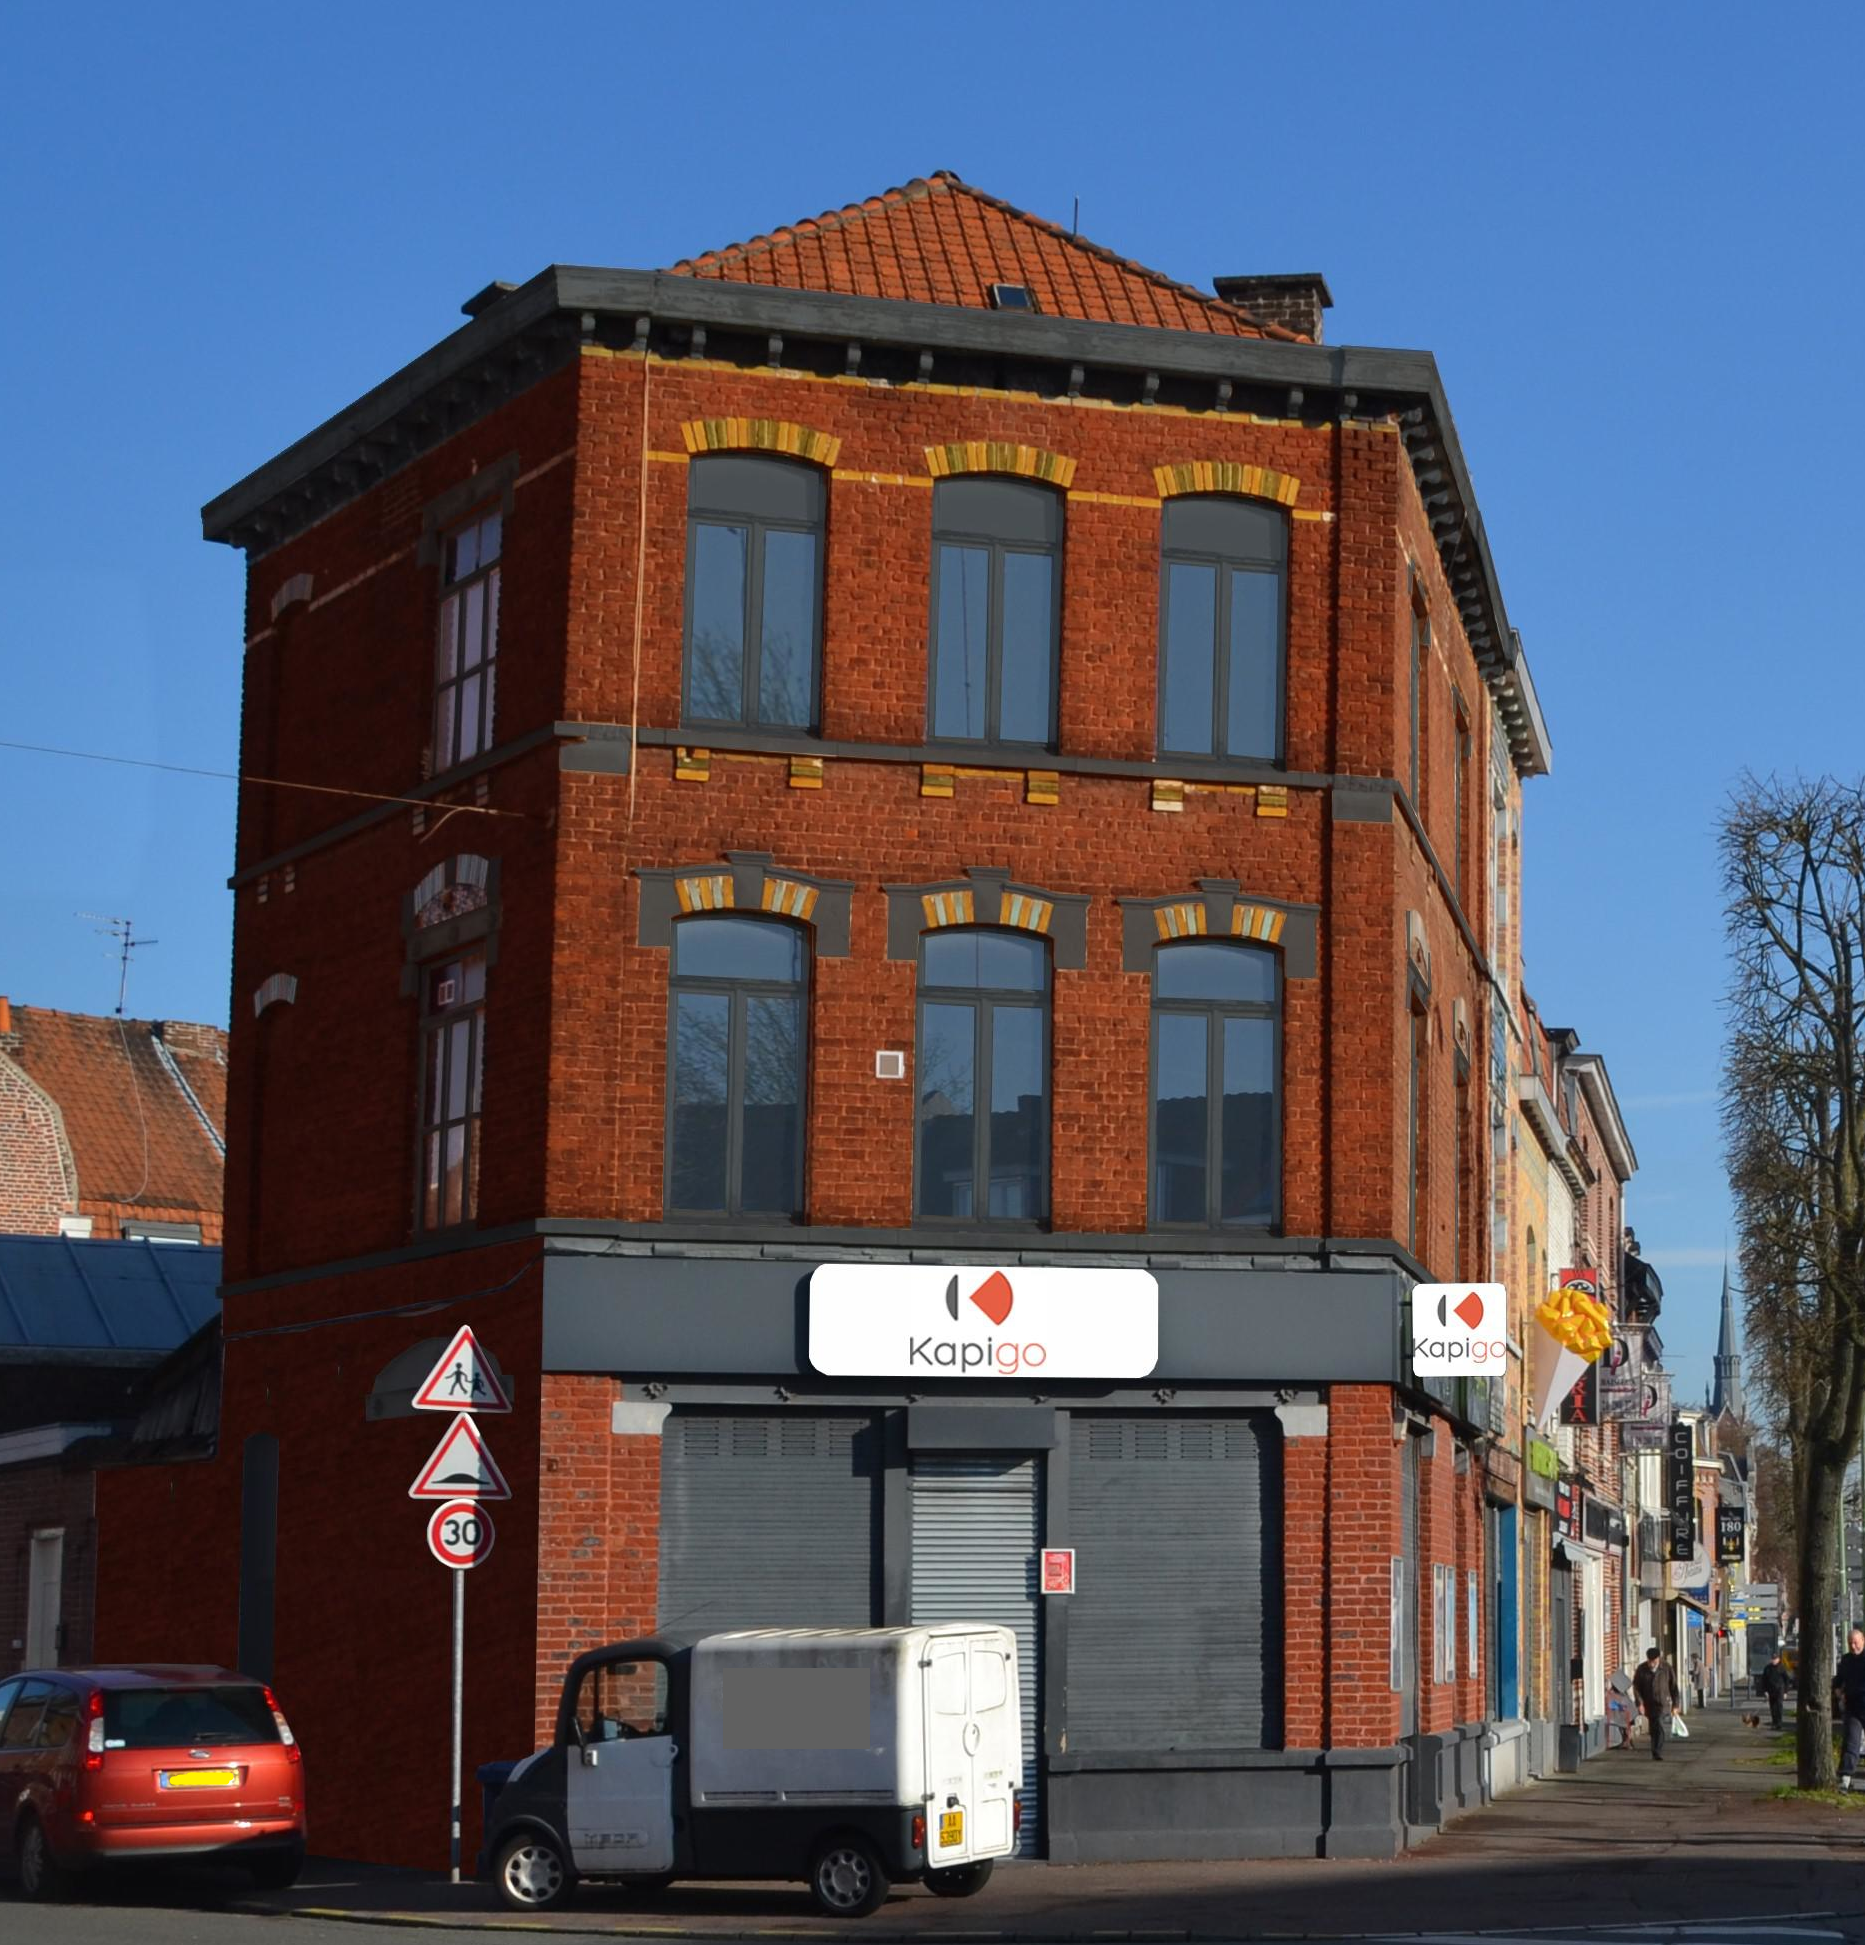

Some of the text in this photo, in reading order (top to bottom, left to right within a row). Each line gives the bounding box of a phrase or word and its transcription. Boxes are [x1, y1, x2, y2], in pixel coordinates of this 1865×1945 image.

[909, 1336, 1047, 1375] Kapigo
[1413, 1337, 1507, 1364] Kapigo
[444, 1518, 482, 1546] 30
[1720, 1521, 1742, 1533] 180
